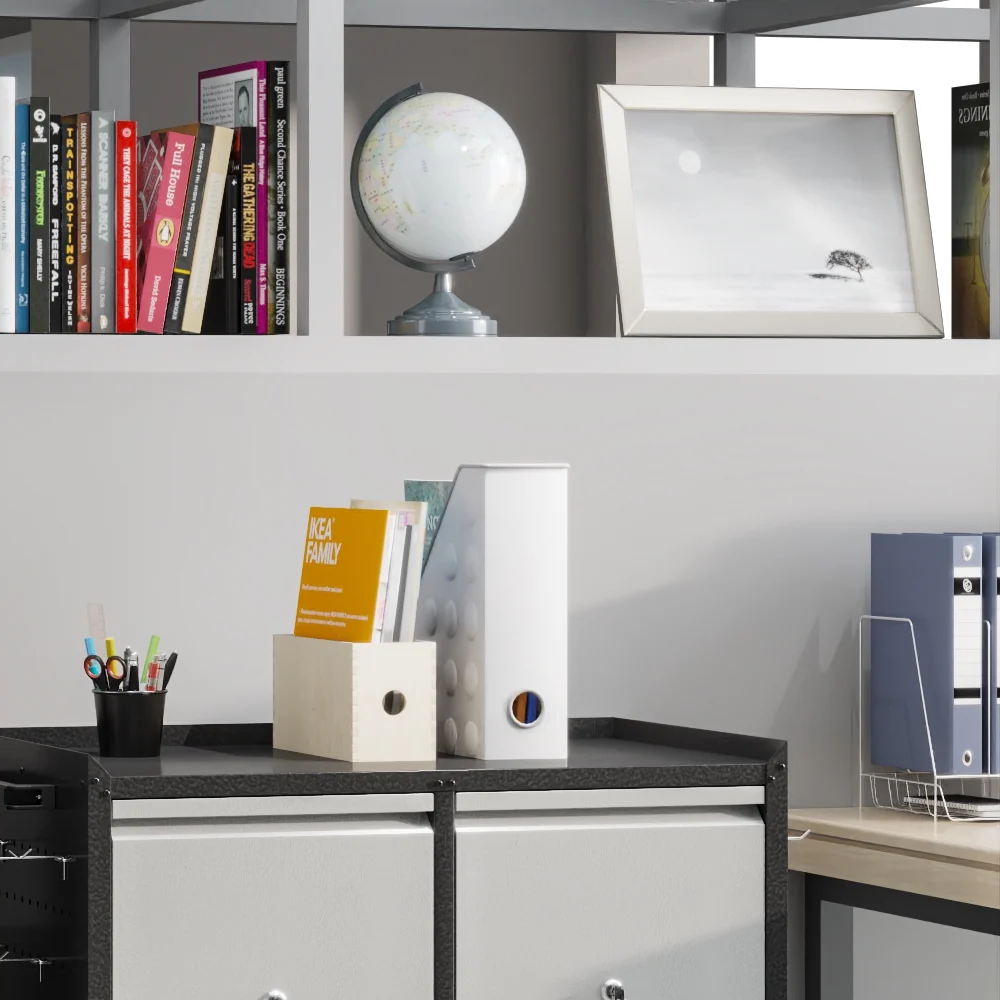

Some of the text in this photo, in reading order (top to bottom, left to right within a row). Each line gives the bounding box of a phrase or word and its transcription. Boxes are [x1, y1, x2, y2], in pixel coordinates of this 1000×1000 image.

[259, 78, 267, 137] This Pleasant Land
[275, 67, 286, 109] paul green
[52, 144, 58, 153] D.
[80, 122, 88, 148] LESSONS
[80, 149, 88, 166] FROM
[52, 154, 58, 163] R.
[80, 168, 88, 179] THE
[98, 117, 109, 242] A SCANNER DARKLY
[165, 142, 185, 207] Full House
[66, 127, 74, 265] TRAINSPOTTING
[80, 180, 88, 213] PHANTOM
[123, 147, 131, 260] THEY CAGE THE ANIMALS AT NIGHT
[276, 119, 287, 251] Second Chance Series Book One
[243, 163, 256, 269] THE GATHERING DEAD
[51, 218, 59, 302] FREEFALL
[80, 264, 88, 310] VICKI HOPKINS
[147, 275, 162, 322] David Sedaris
[275, 268, 286, 326] BEGINNINGS
[308, 517, 333, 541] IKEA
[305, 541, 342, 565] FAMILY
